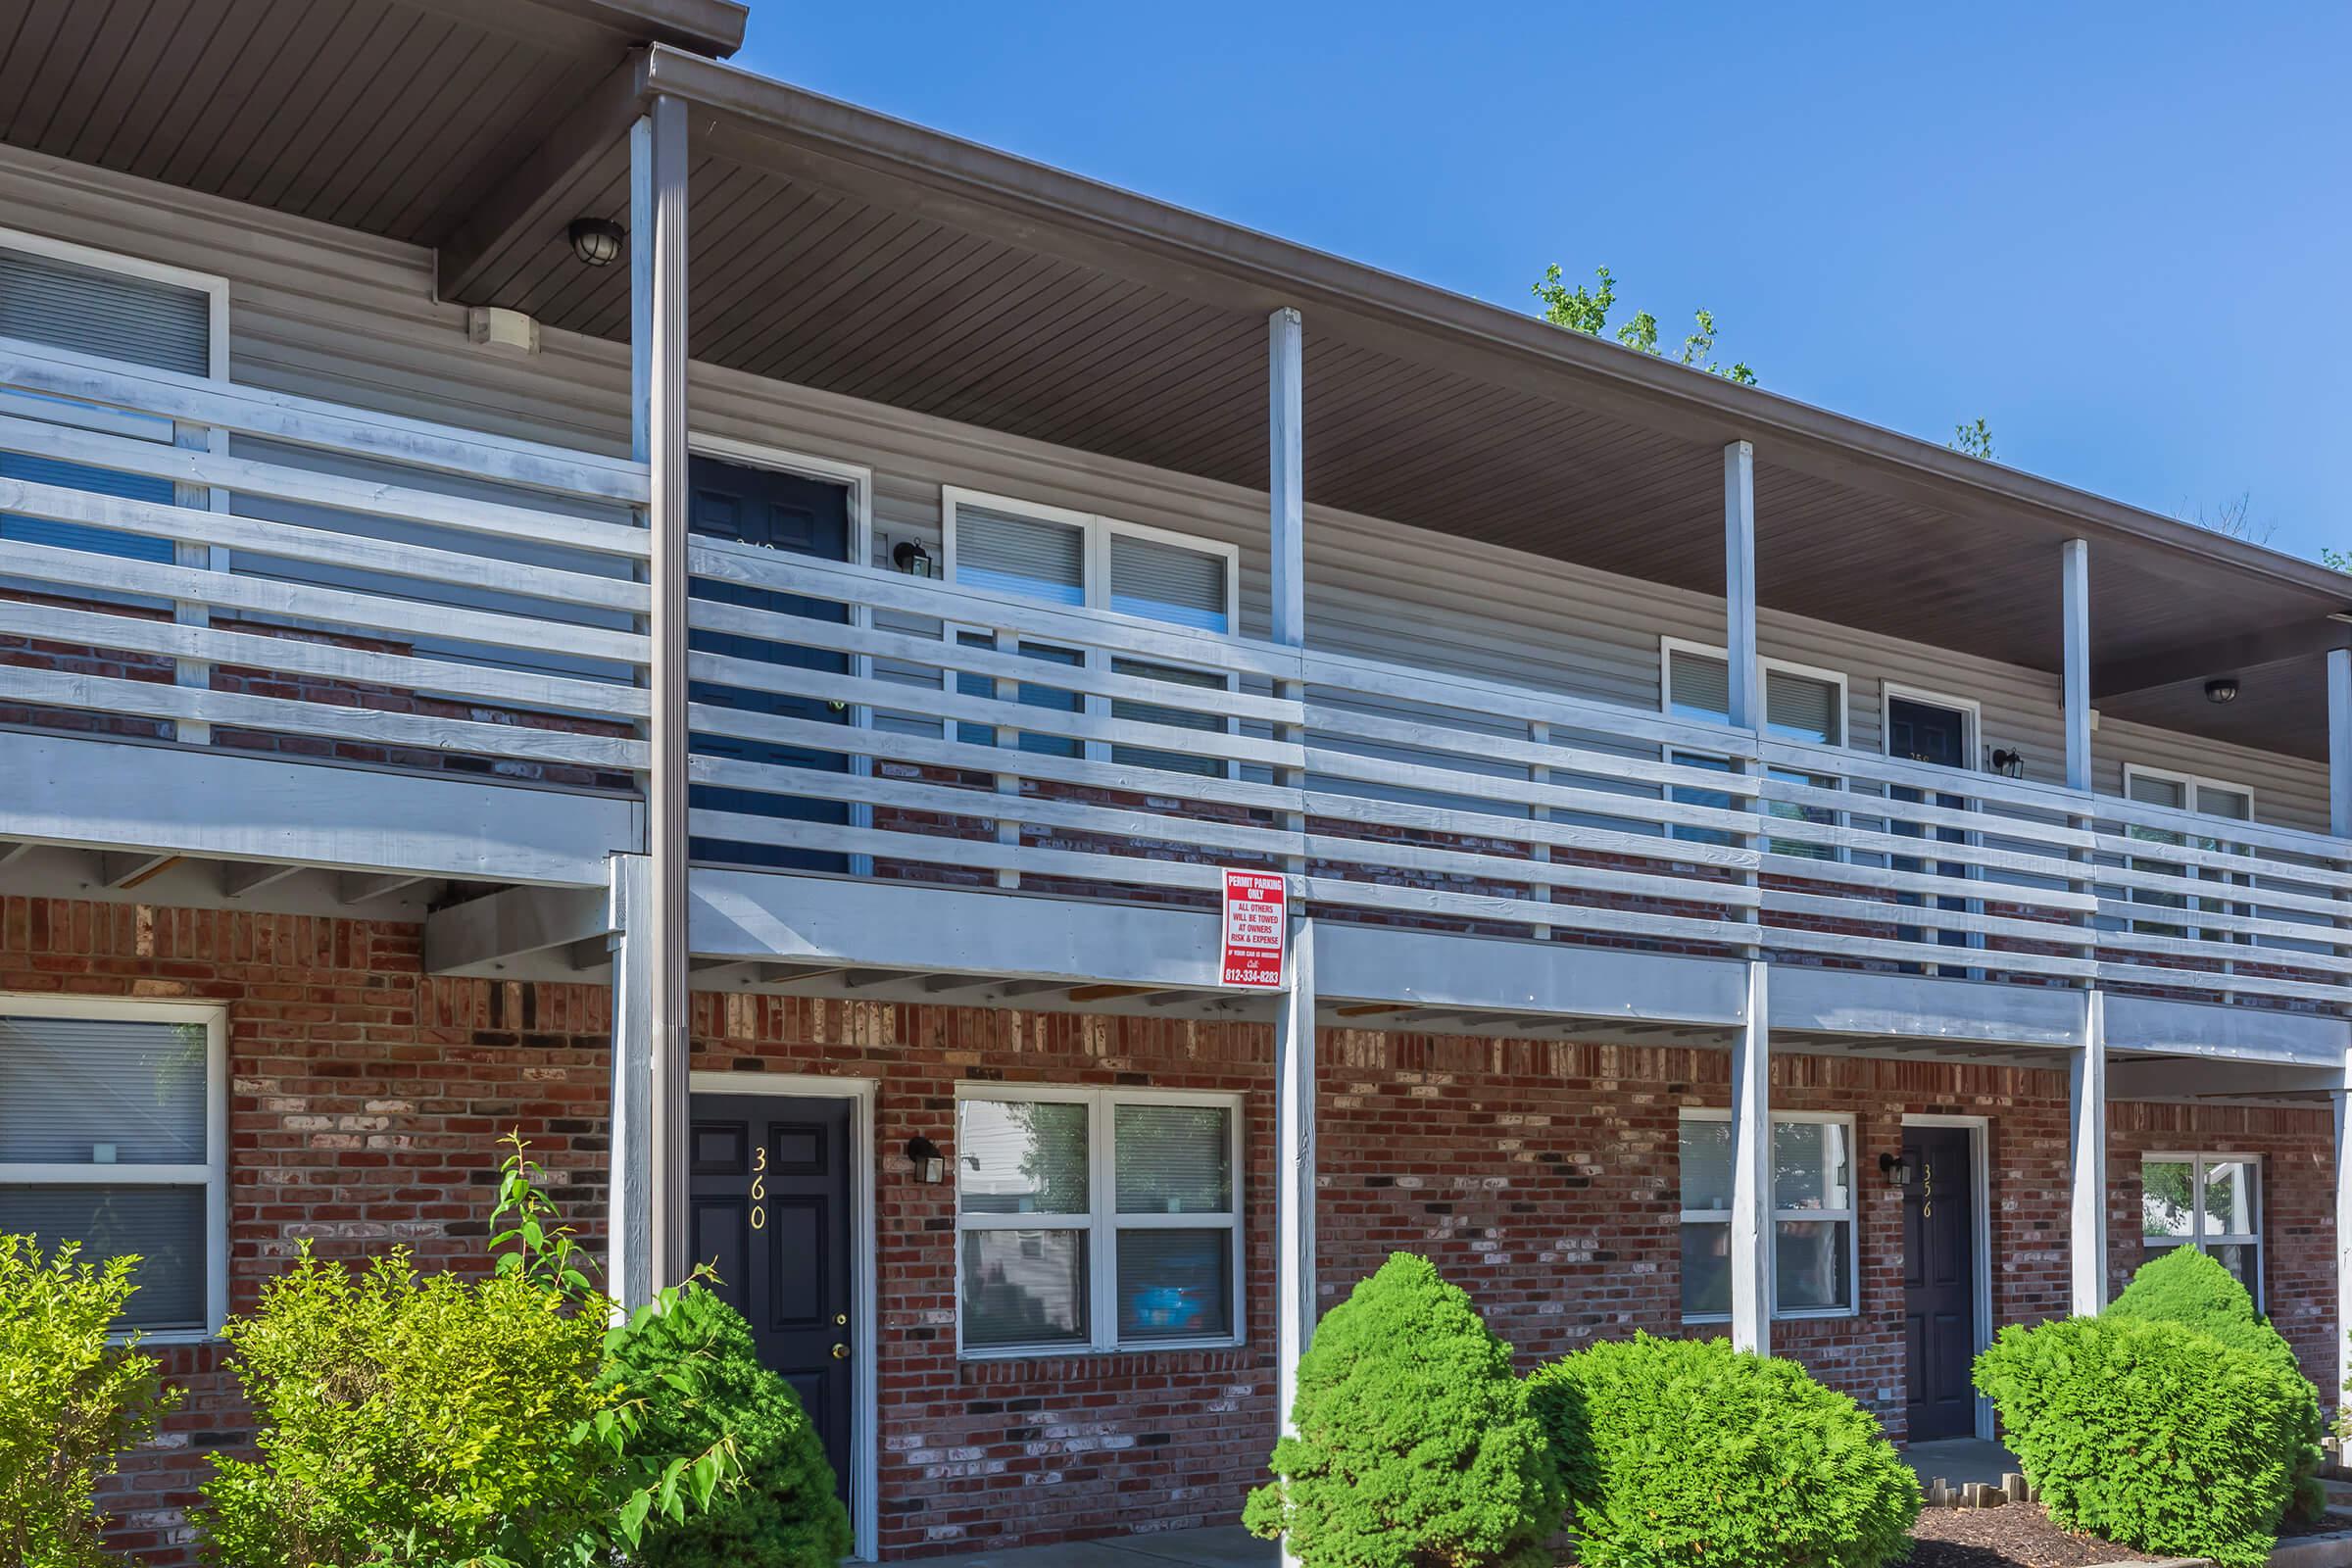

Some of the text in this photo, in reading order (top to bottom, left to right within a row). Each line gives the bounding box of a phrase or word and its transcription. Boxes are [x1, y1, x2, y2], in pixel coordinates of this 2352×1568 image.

[1228, 875, 1282, 890] PERMIT PARKING
[1248, 889, 1264, 900] ONLY
[1238, 903, 1273, 913] ALL OTHERS
[1233, 912, 1247, 921] WILL
[1258, 915, 1278, 924] TOWED
[1238, 923, 1272, 934] AT OWNERS
[1252, 935, 1278, 945] EXPENSE
[1225, 968, 1278, 983] 812-334-8283
[751, 1147, 766, 1229] 360
